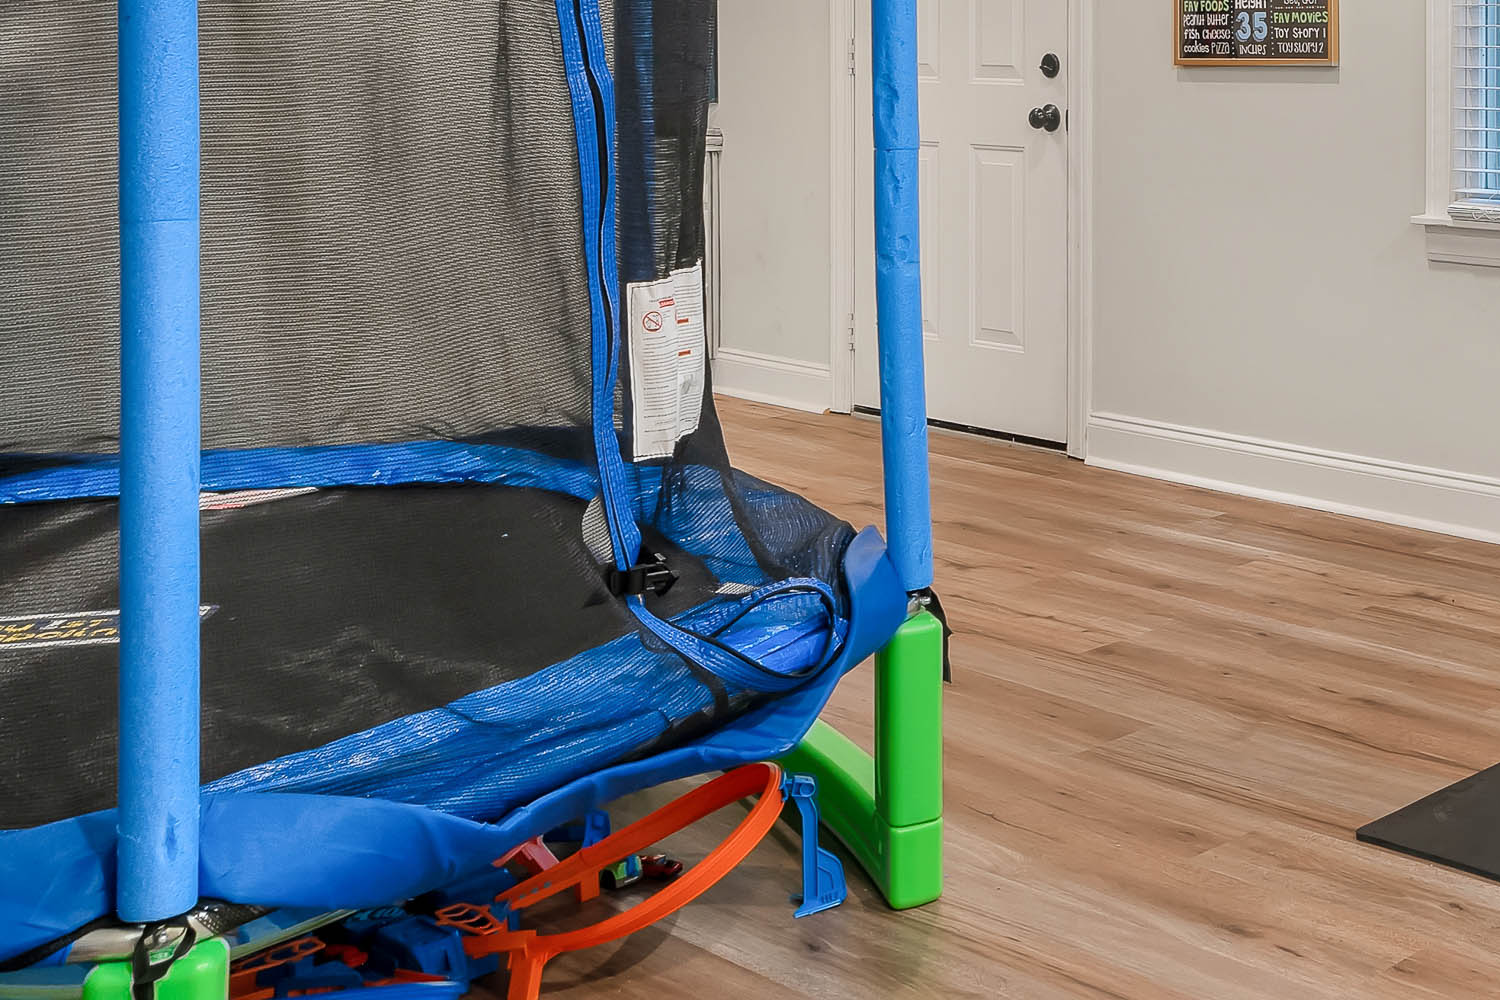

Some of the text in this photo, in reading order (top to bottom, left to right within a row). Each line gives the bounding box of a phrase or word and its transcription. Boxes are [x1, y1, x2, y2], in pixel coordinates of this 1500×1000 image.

[1184, 0, 1199, 12] FAV
[1273, 12, 1290, 23] FAV
[1235, 11, 1268, 42] 35
